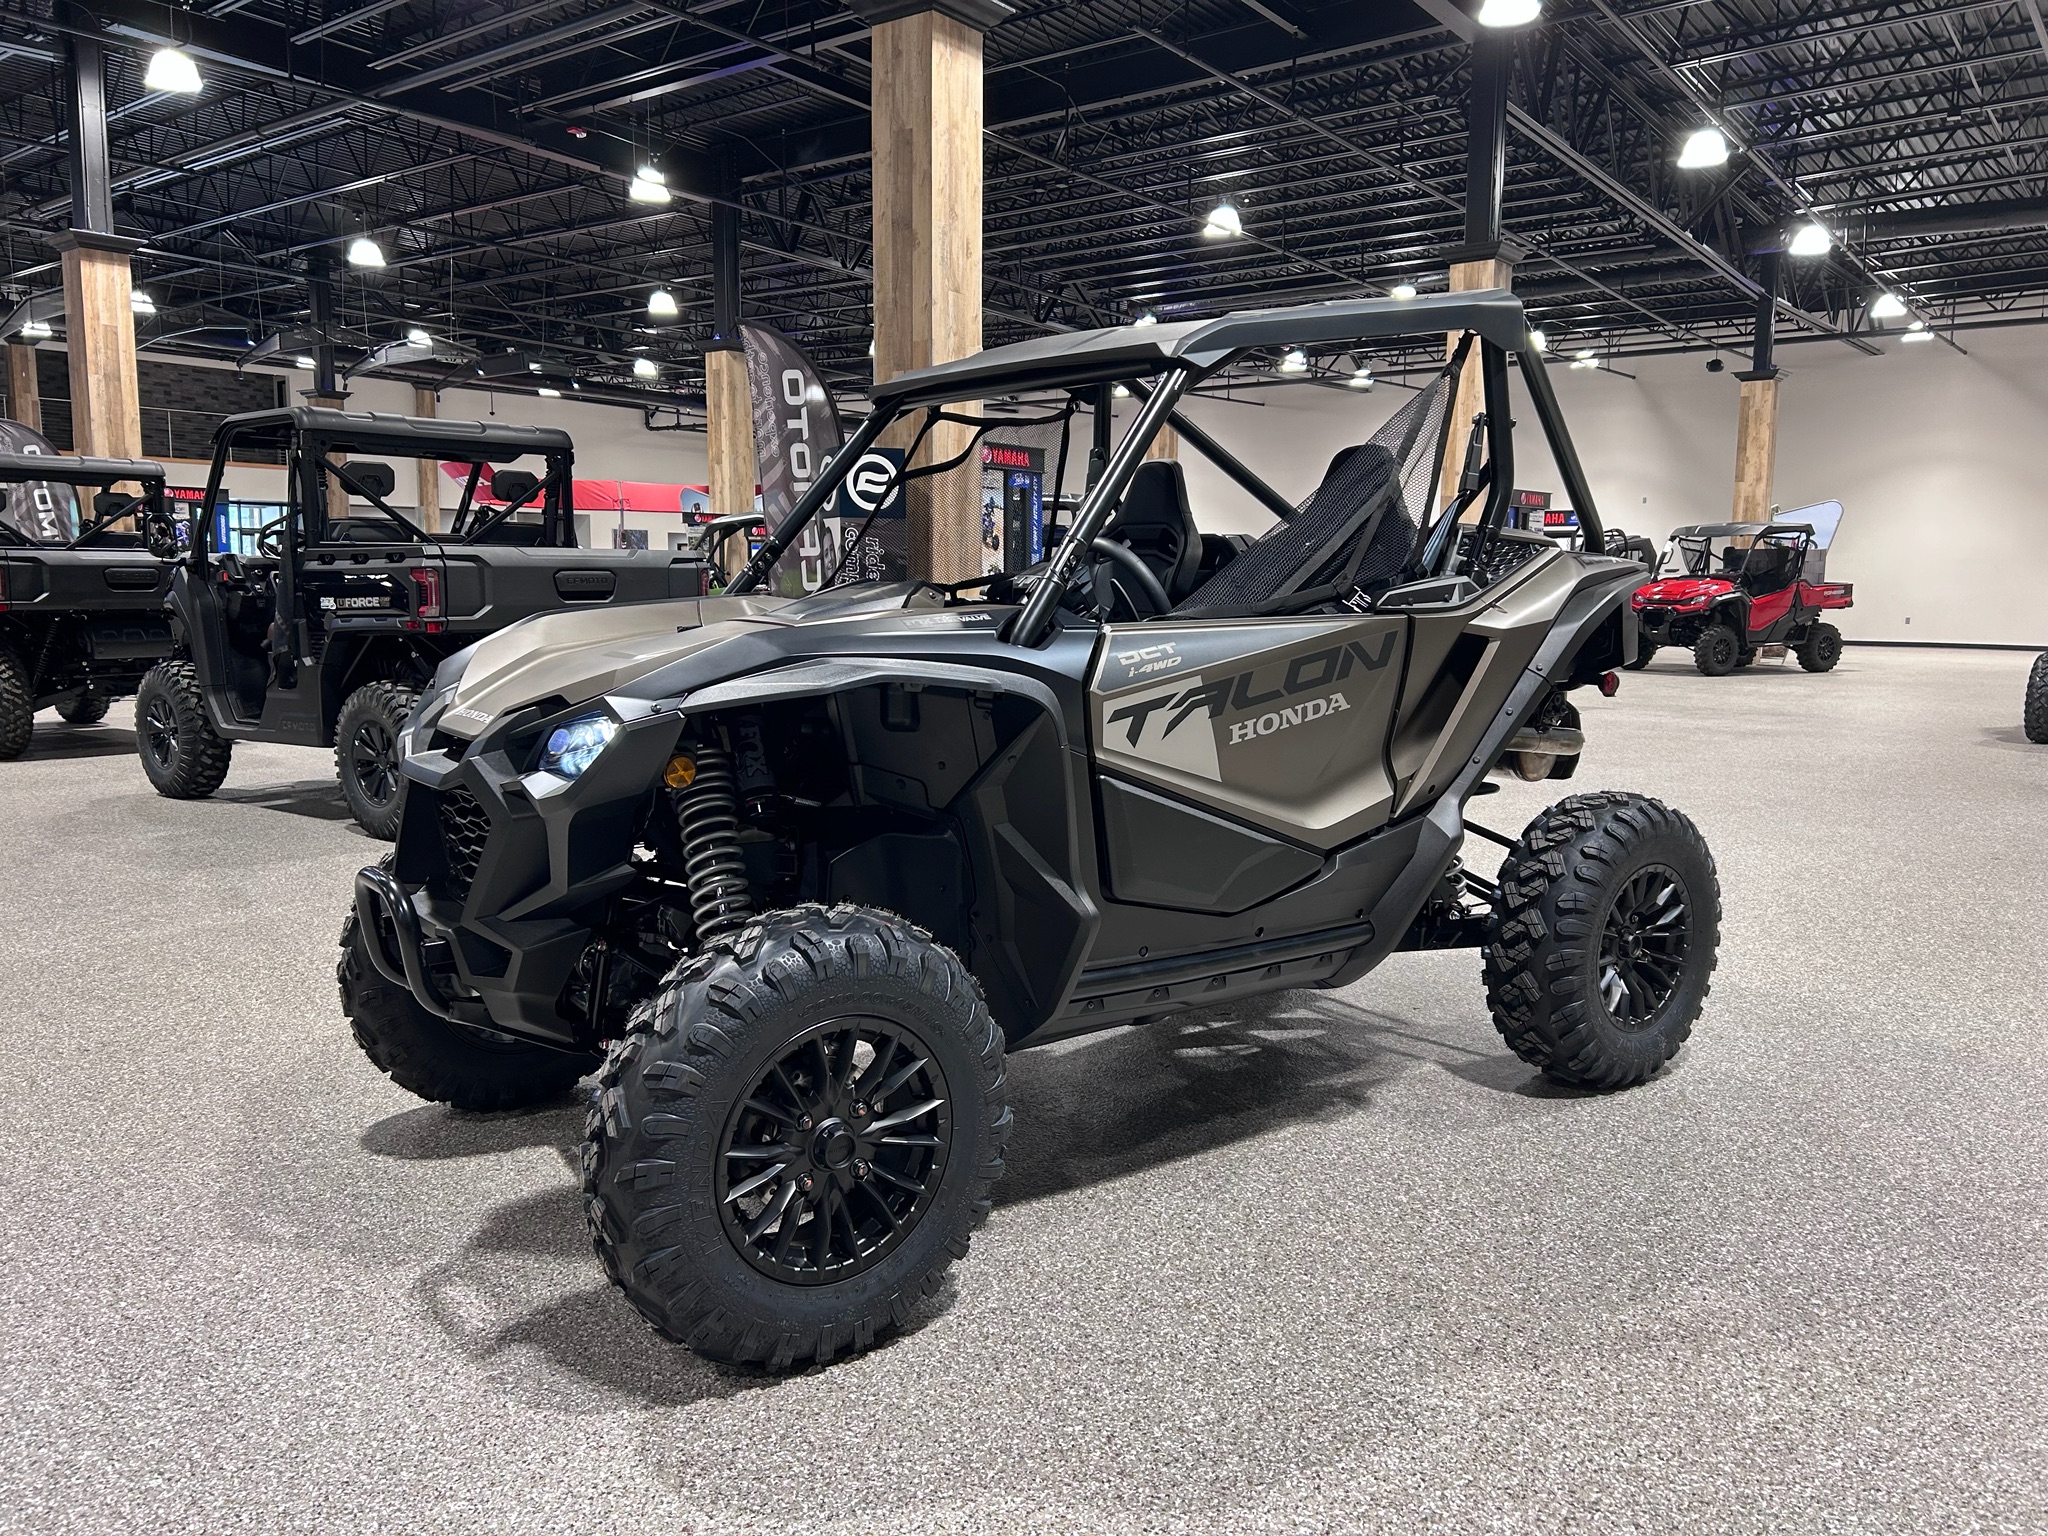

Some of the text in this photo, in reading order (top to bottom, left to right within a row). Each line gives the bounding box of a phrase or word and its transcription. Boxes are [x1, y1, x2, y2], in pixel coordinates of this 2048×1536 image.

[992, 447, 1030, 467] YAMAHA
[174, 489, 206, 500] YAMAH
[1545, 513, 1565, 524] AHA
[865, 537, 886, 582] ride
[566, 577, 609, 585] CFMOTO
[1116, 641, 1177, 666] DCT
[1128, 656, 1182, 678] i-4WD
[1106, 629, 1400, 749] TALON
[455, 708, 495, 724] HONDA
[1229, 692, 1351, 746] HONDA
[689, 1099, 728, 1256] KENDA
